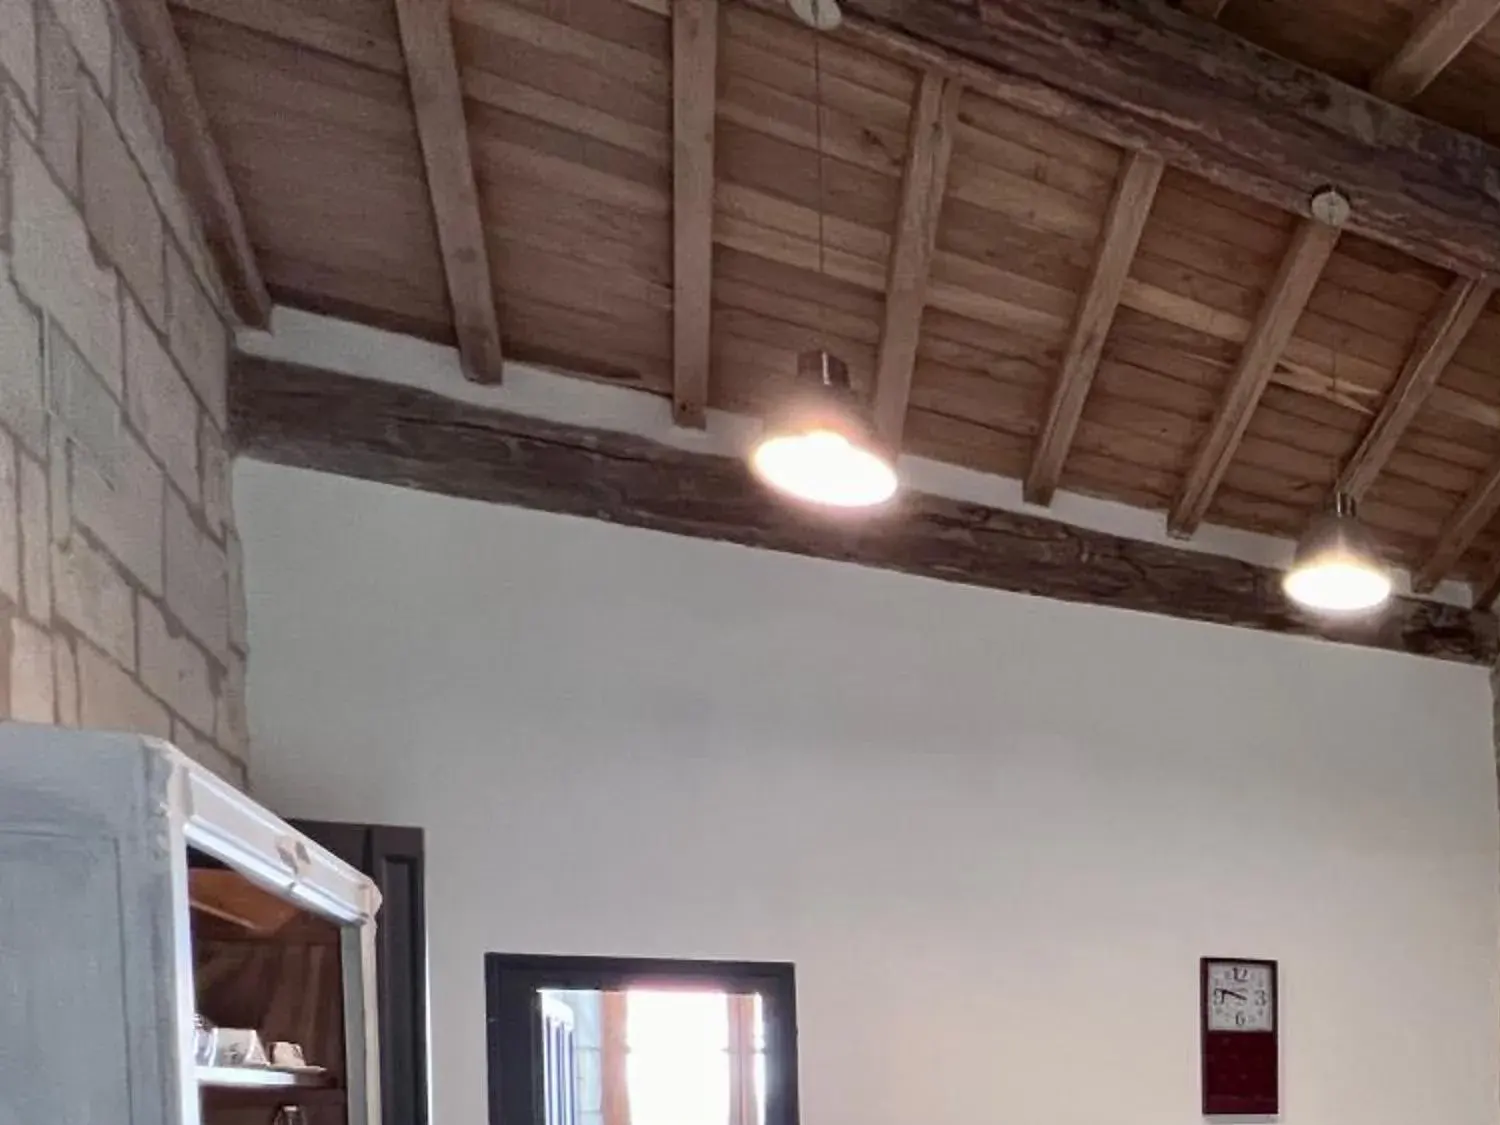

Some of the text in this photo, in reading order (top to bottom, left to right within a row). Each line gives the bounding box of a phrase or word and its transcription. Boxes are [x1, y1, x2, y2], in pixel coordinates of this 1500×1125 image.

[1232, 967, 1248, 982] 12
[1254, 989, 1266, 1006] 3
[1235, 1010, 1245, 1026] 6
